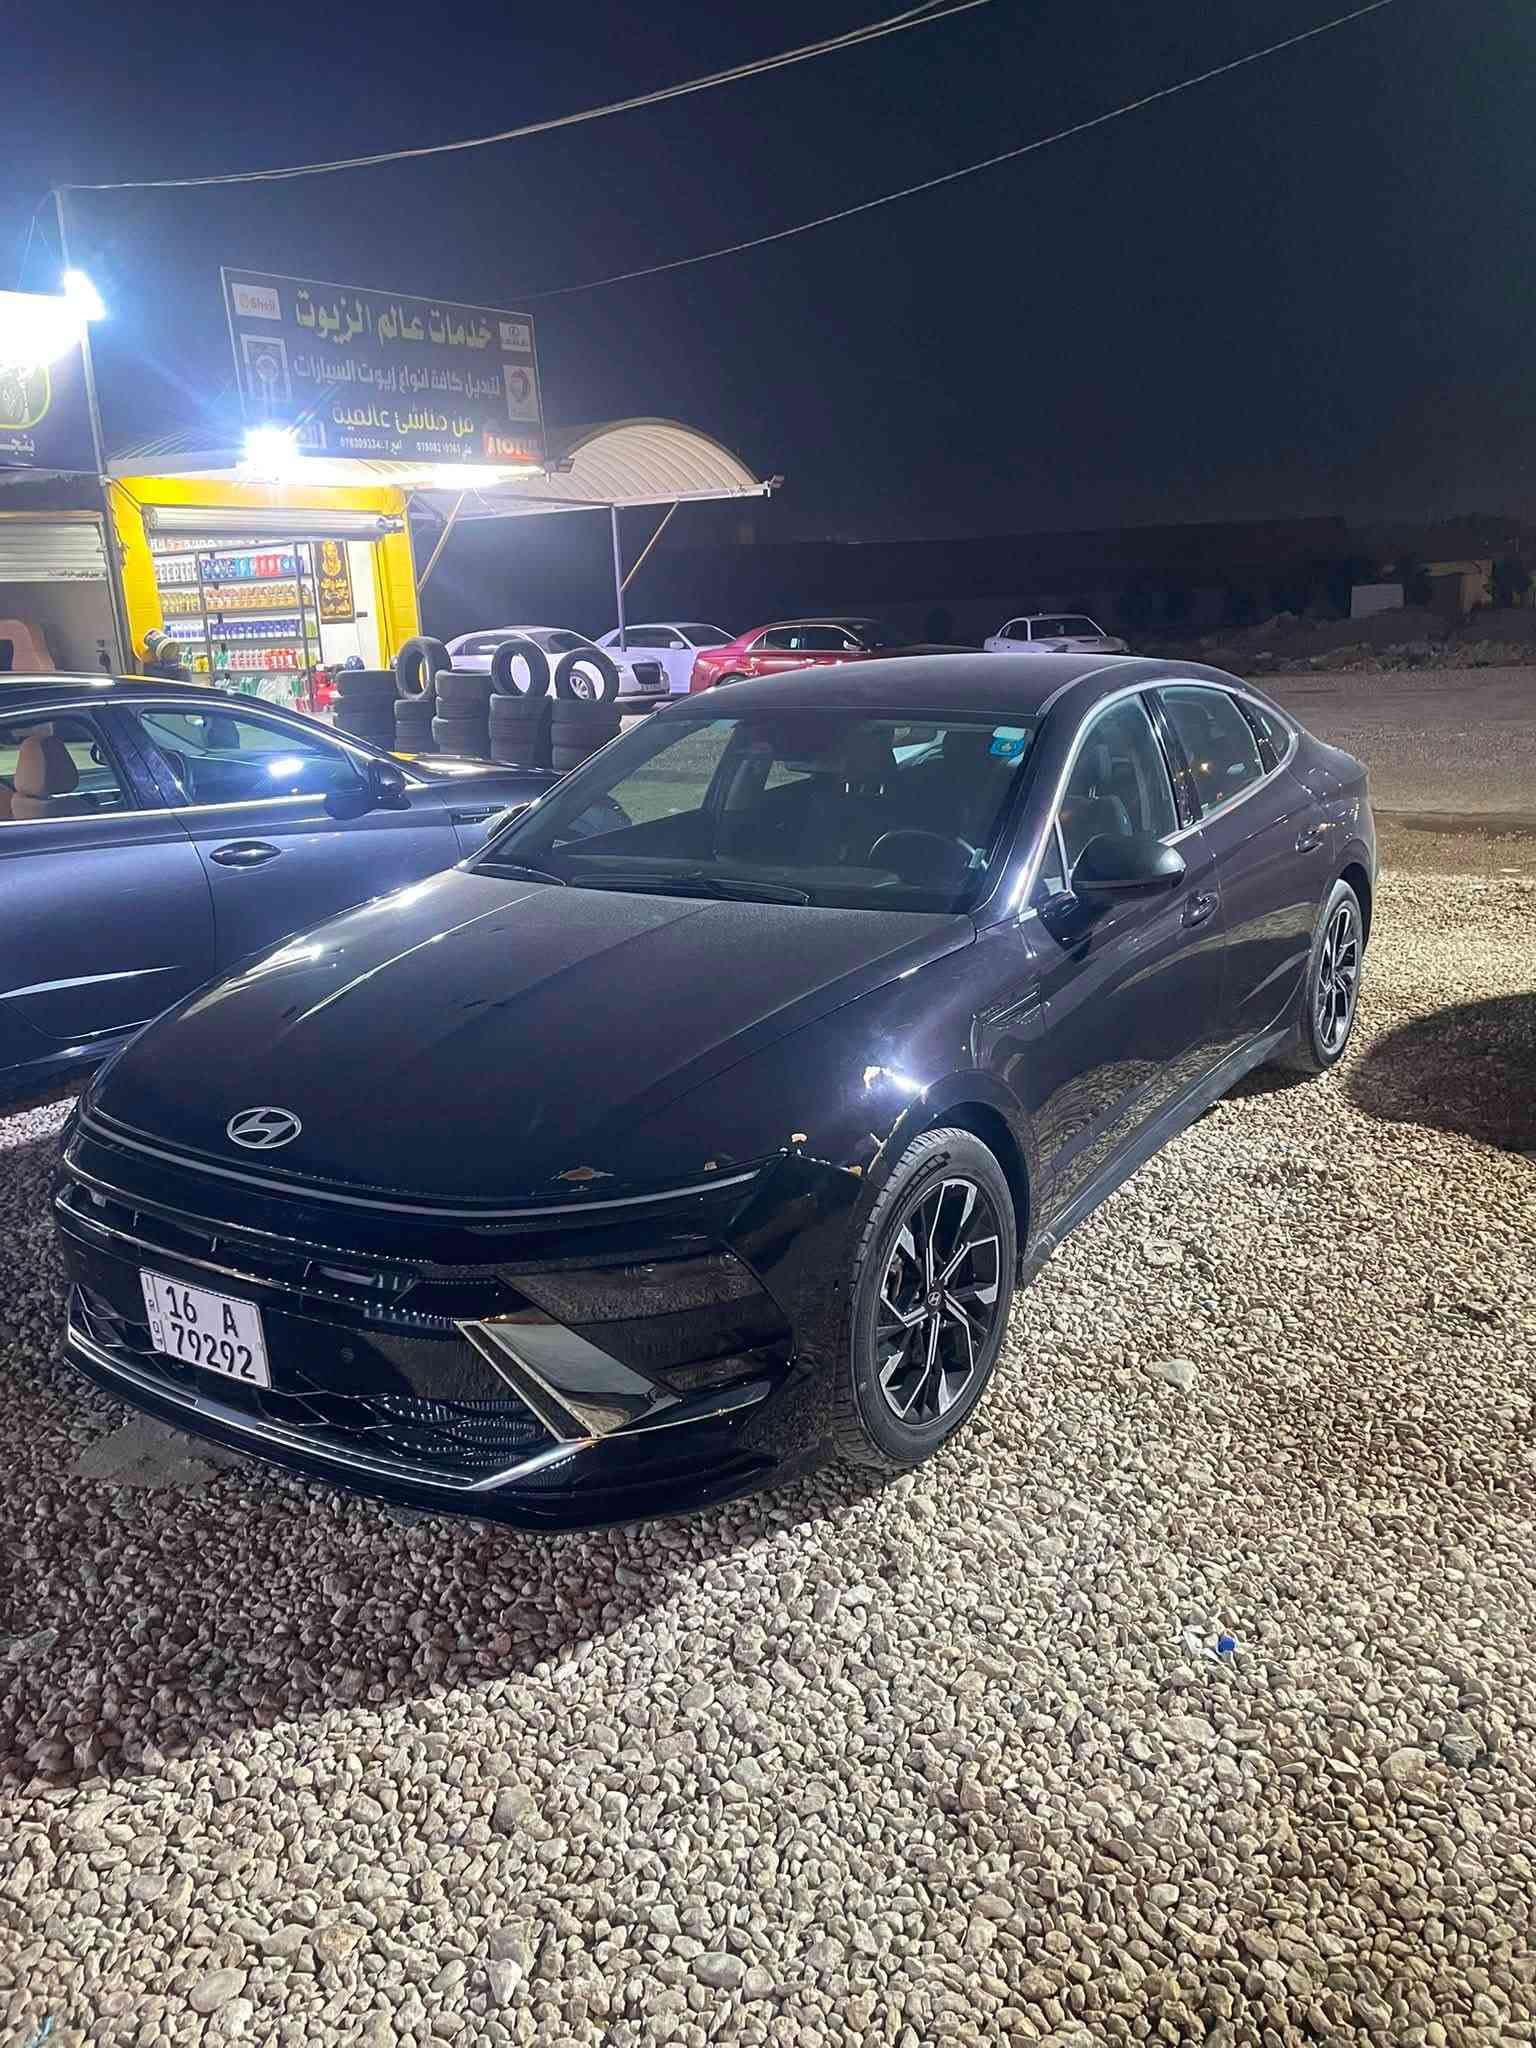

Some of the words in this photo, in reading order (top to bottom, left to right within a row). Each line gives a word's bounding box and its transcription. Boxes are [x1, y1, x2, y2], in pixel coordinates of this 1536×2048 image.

[295, 288, 373, 345] الزيوت
[377, 303, 425, 350] عالم
[428, 308, 492, 349] خدمات
[293, 355, 356, 385] السيارات
[431, 367, 464, 392] كافة
[332, 401, 391, 431] عالمية
[394, 403, 448, 434] مناشئ
[452, 410, 474, 438] من
[166, 1286, 198, 1324] 16
[222, 1303, 239, 1338] A
[171, 1322, 256, 1380] 79292
